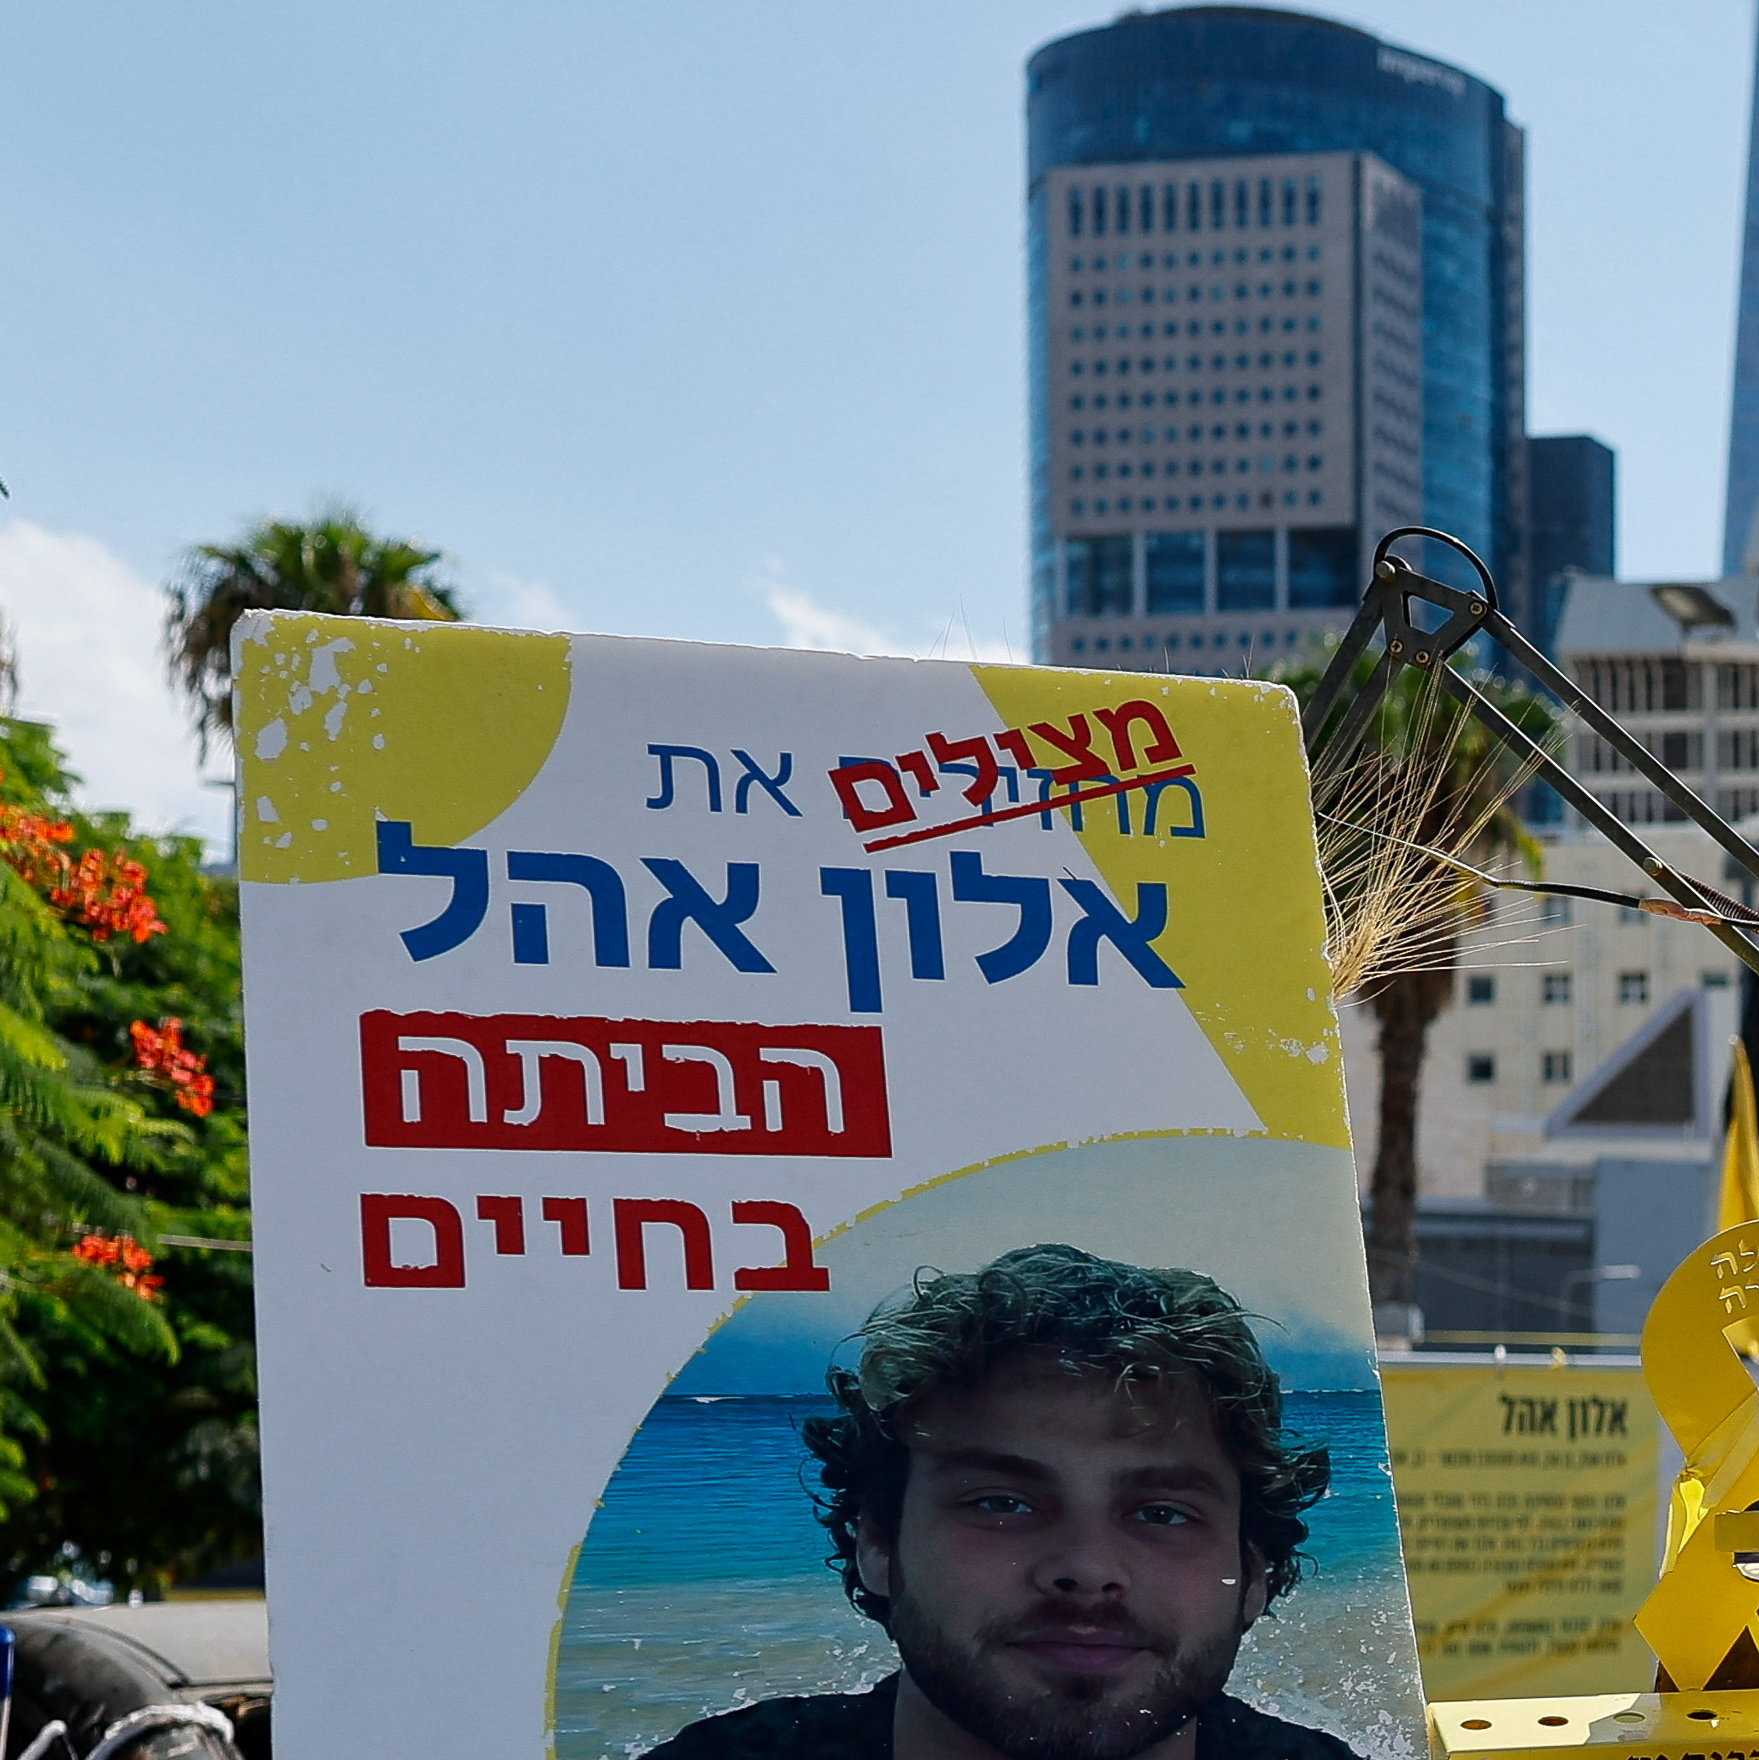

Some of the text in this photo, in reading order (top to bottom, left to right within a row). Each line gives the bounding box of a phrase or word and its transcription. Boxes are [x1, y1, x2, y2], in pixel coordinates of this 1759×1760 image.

[646, 742, 802, 817] את
[829, 697, 1182, 836] מצילים
[377, 820, 1186, 1014] אלון אהל
[397, 1033, 847, 1137] הביתה
[361, 1193, 832, 1292] בחיים
[1500, 1388, 1629, 1442] אלון אהל
